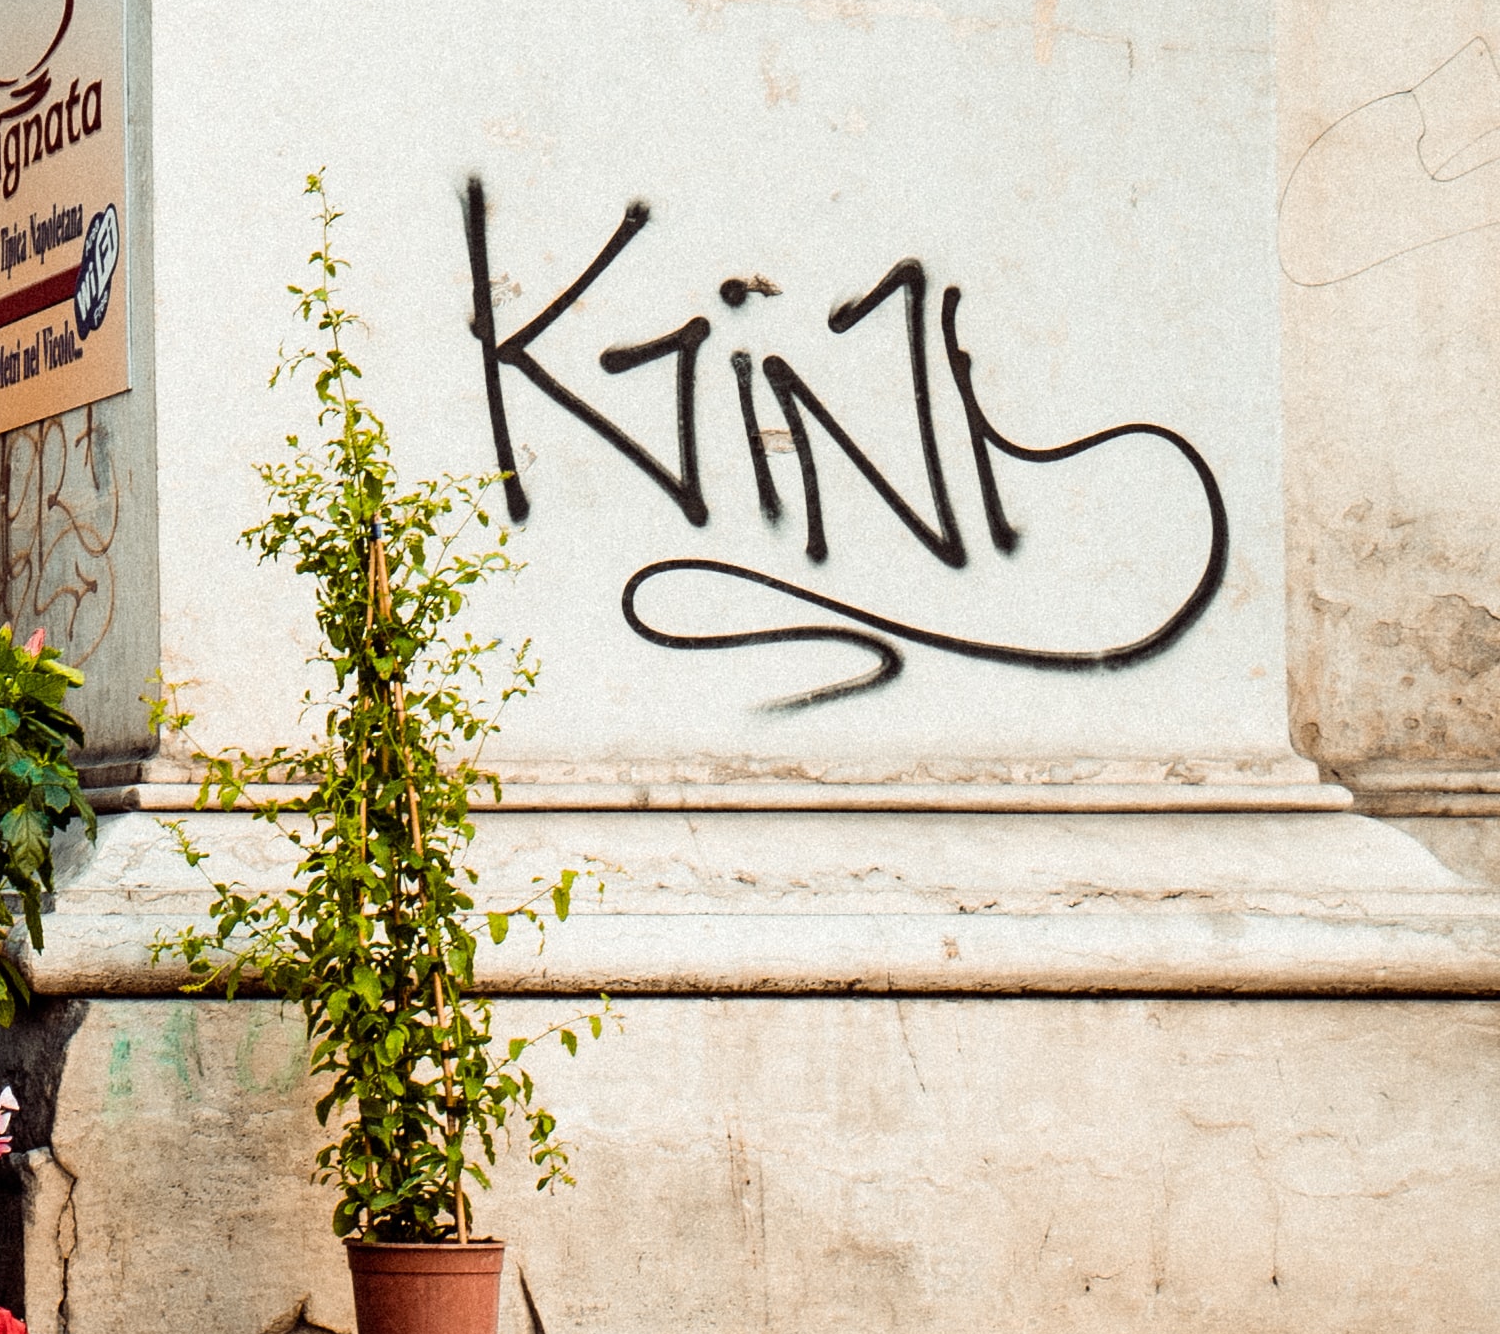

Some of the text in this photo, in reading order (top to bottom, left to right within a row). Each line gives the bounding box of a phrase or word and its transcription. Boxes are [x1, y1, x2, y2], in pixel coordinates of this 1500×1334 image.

[0, 222, 27, 280] Tipica
[28, 202, 83, 265] Napoletana
[23, 332, 40, 380] nel
